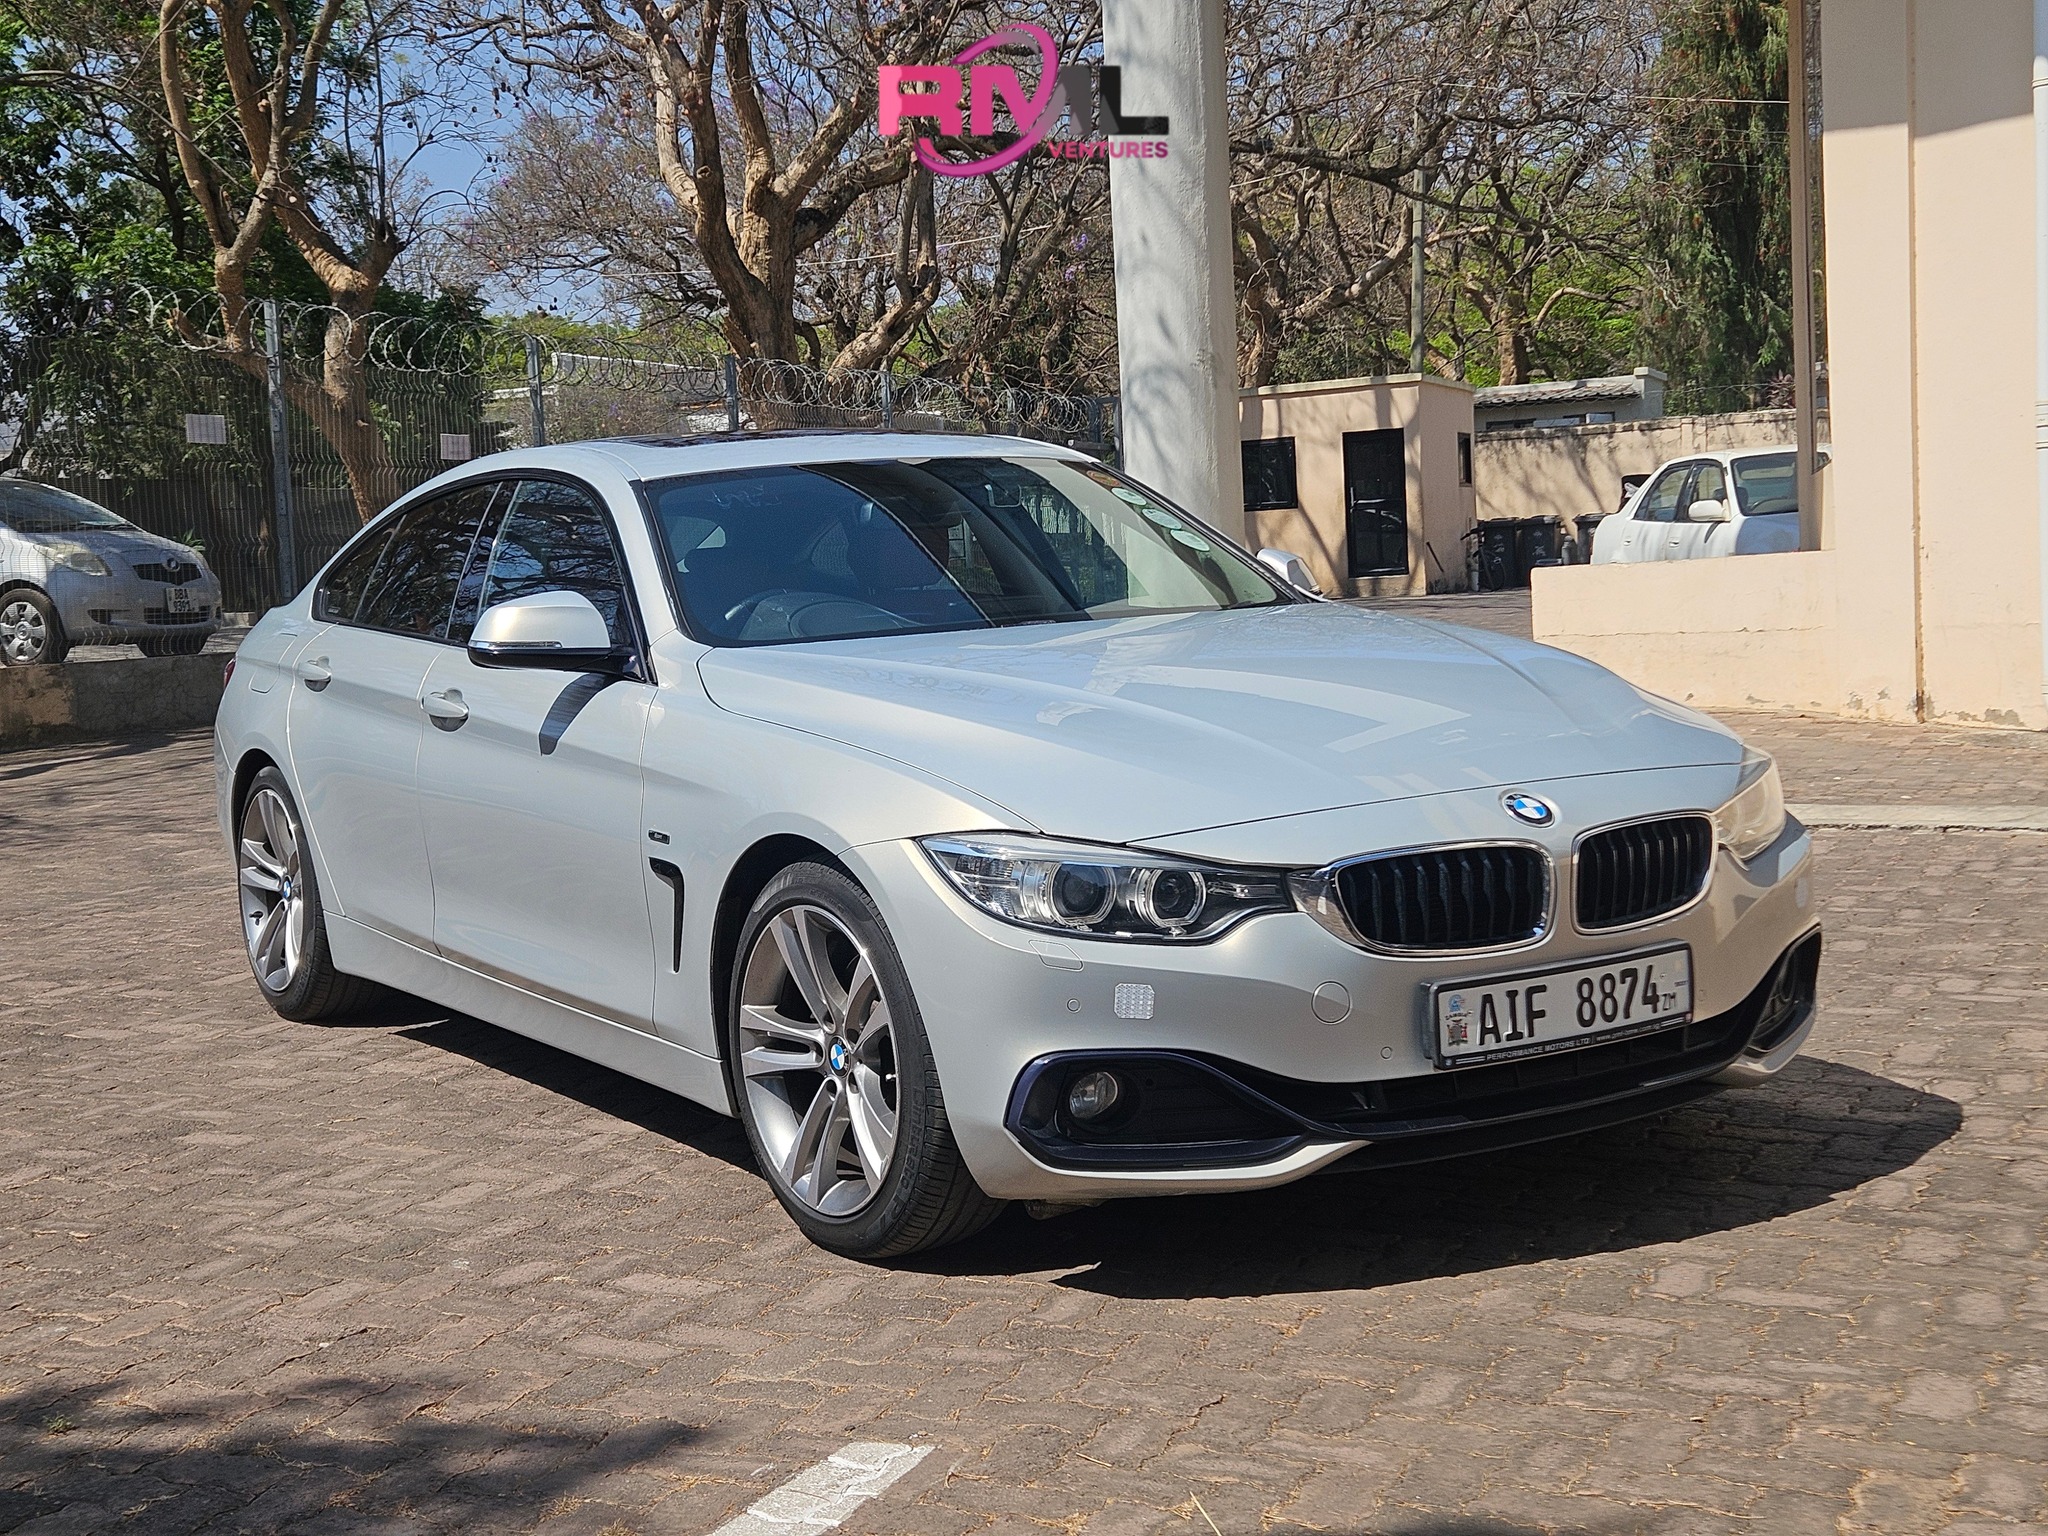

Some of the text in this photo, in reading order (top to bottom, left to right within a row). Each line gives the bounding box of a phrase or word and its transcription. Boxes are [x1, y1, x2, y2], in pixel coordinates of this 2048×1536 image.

[1477, 984, 1547, 1046] AIF
[1576, 964, 1660, 1028] 8874
[1486, 1046, 1543, 1061] PERFORMANCE
[1545, 1040, 1576, 1052] MOTORS
[1577, 1037, 1591, 1047] LTD
